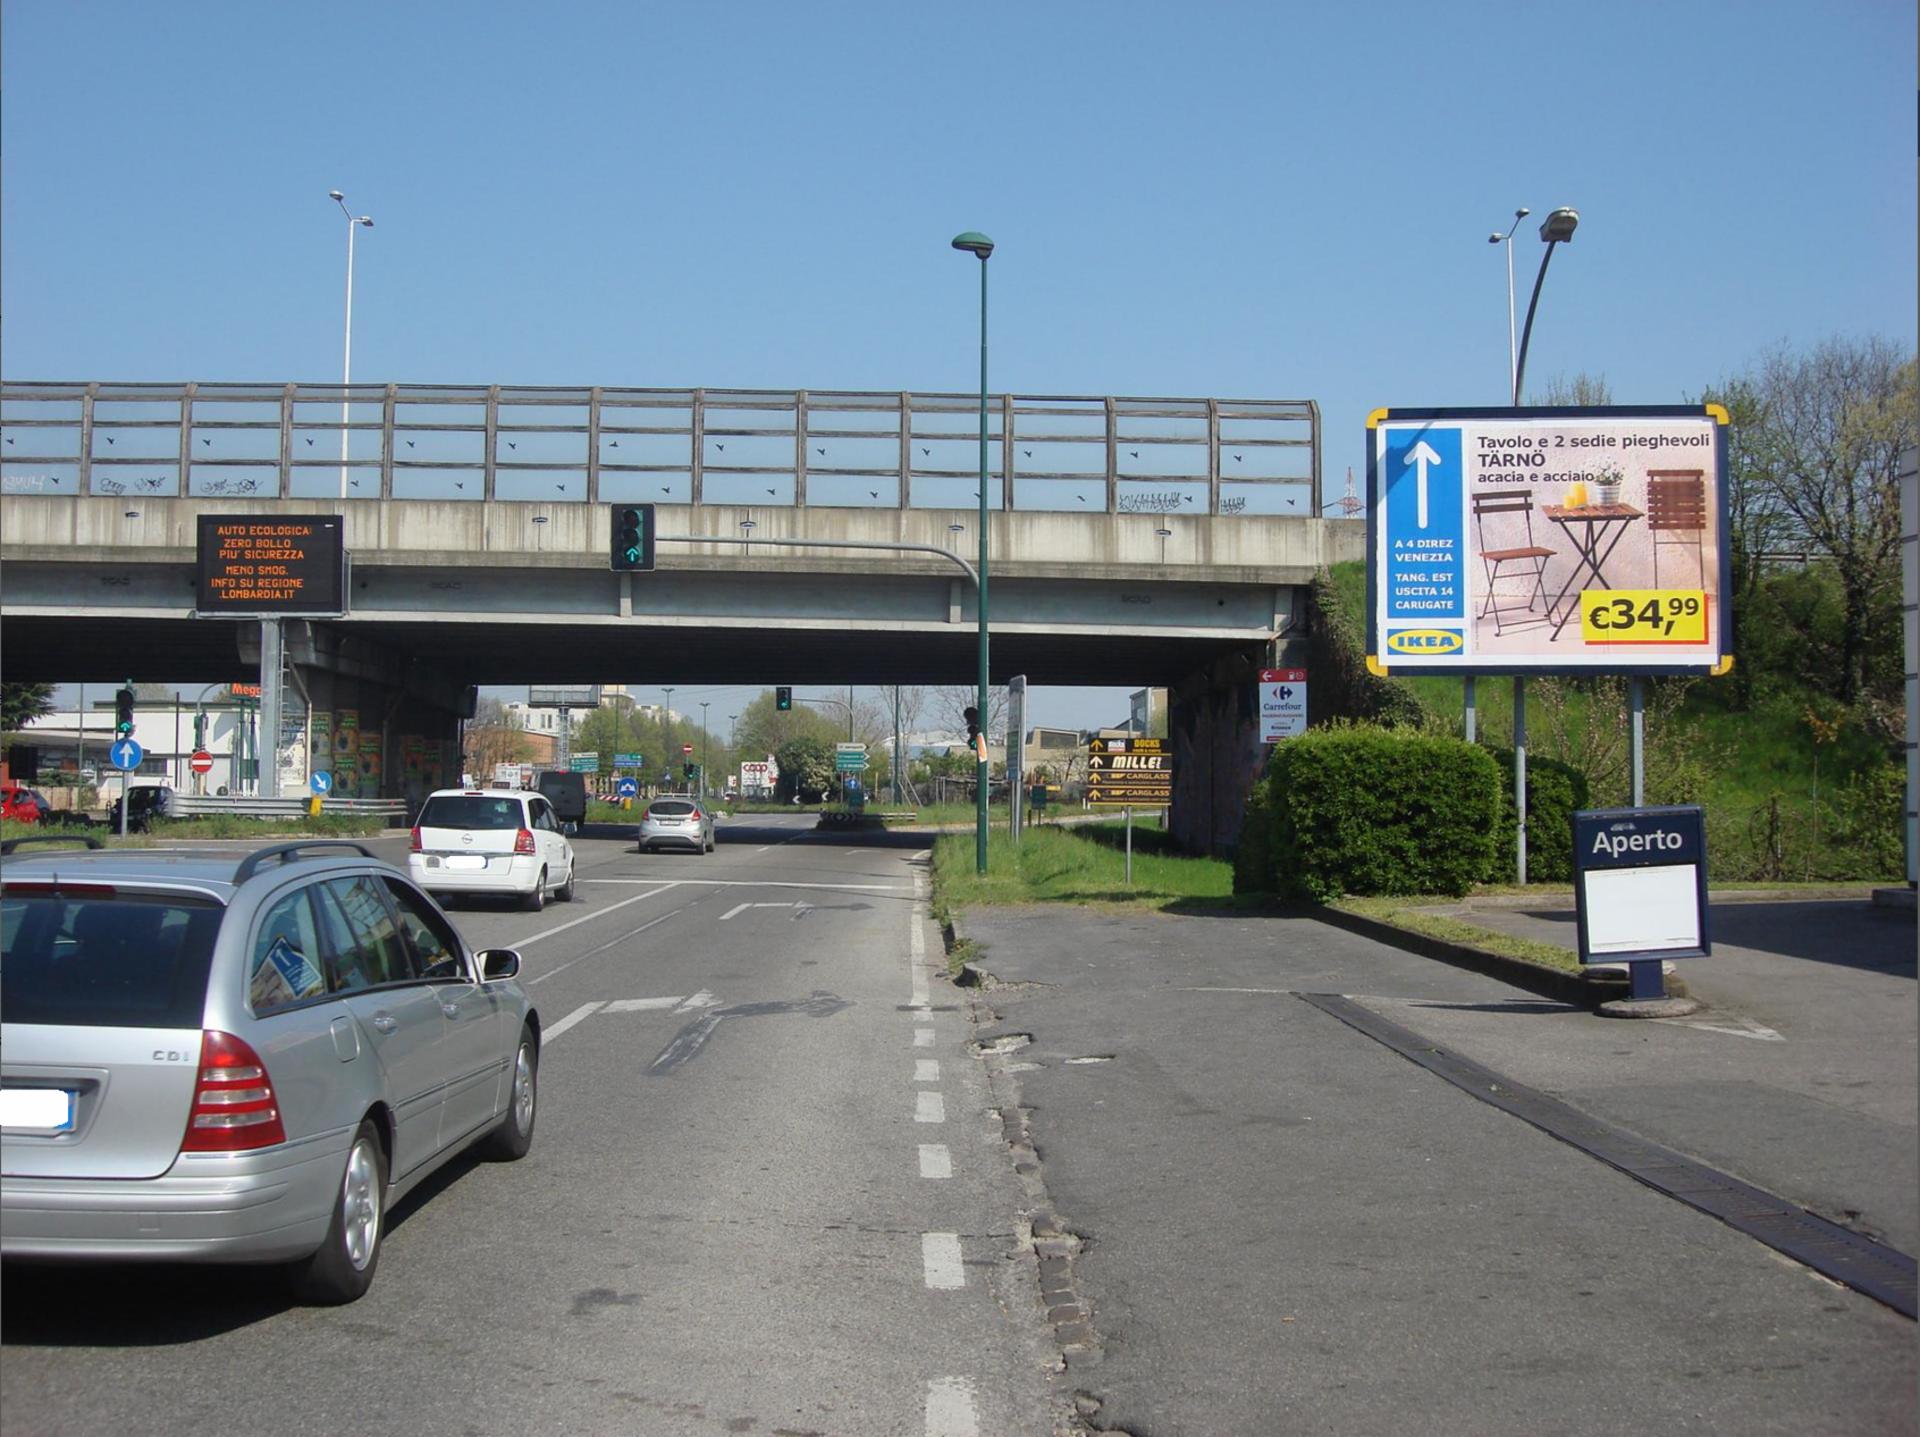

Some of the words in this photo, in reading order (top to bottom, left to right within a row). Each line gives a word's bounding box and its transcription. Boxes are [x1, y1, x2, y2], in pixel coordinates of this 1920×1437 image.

[1478, 435, 1532, 448] Tavolo
[1538, 438, 1549, 448] e
[1554, 435, 1566, 448] 2
[1570, 434, 1617, 448] sedie
[1622, 433, 1710, 450] pieghevoli
[1478, 450, 1546, 468] TÄRNÖ
[1478, 471, 1525, 483] acacia
[1529, 473, 1539, 482] e
[1543, 470, 1595, 483] acciaio
[217, 526, 246, 536] AUTO
[224, 539, 252, 549] ZERO
[256, 539, 292, 549] BOLLO
[1395, 539, 1404, 549] A
[1406, 540, 1415, 549] 4
[1417, 539, 1454, 549] DIREZ
[244, 549, 305, 560] SICUREZZA
[1395, 553, 1453, 563] VENEZIA
[225, 565, 254, 576] MENO
[258, 565, 289, 576] SMOG.
[1395, 573, 1430, 582] TANG.
[1432, 573, 1454, 582] EST
[211, 578, 236, 588] INFO
[240, 578, 254, 588] SU
[258, 578, 304, 588] REGIONE
[1395, 587, 1438, 596] USCITA
[1440, 587, 1454, 596] 14
[1395, 600, 1454, 610] CARUGATE
[1397, 635, 1456, 648] IKEA
[1263, 702, 1303, 711] Carrefour
[1126, 789, 1170, 797] CARGLASS
[1592, 829, 1683, 858] Aperto
